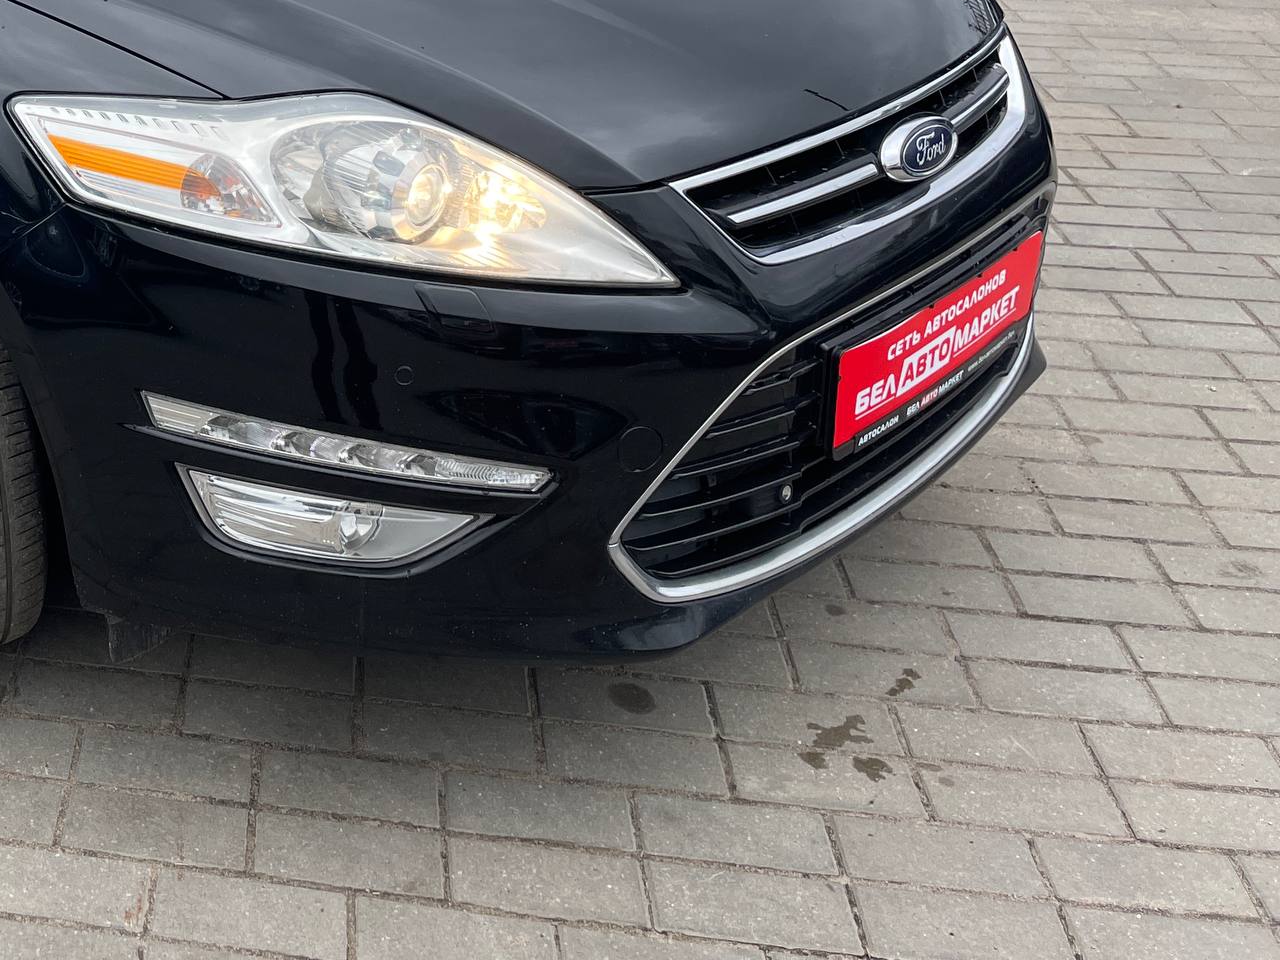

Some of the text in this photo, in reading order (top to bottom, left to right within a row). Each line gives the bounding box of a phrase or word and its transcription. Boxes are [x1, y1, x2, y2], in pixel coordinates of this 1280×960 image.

[916, 131, 946, 166] Ford
[887, 329, 921, 361] СЕТЬ
[924, 269, 1007, 337] АВТОСАЛОНОВ
[858, 415, 899, 446] АВТОСАЛОН
